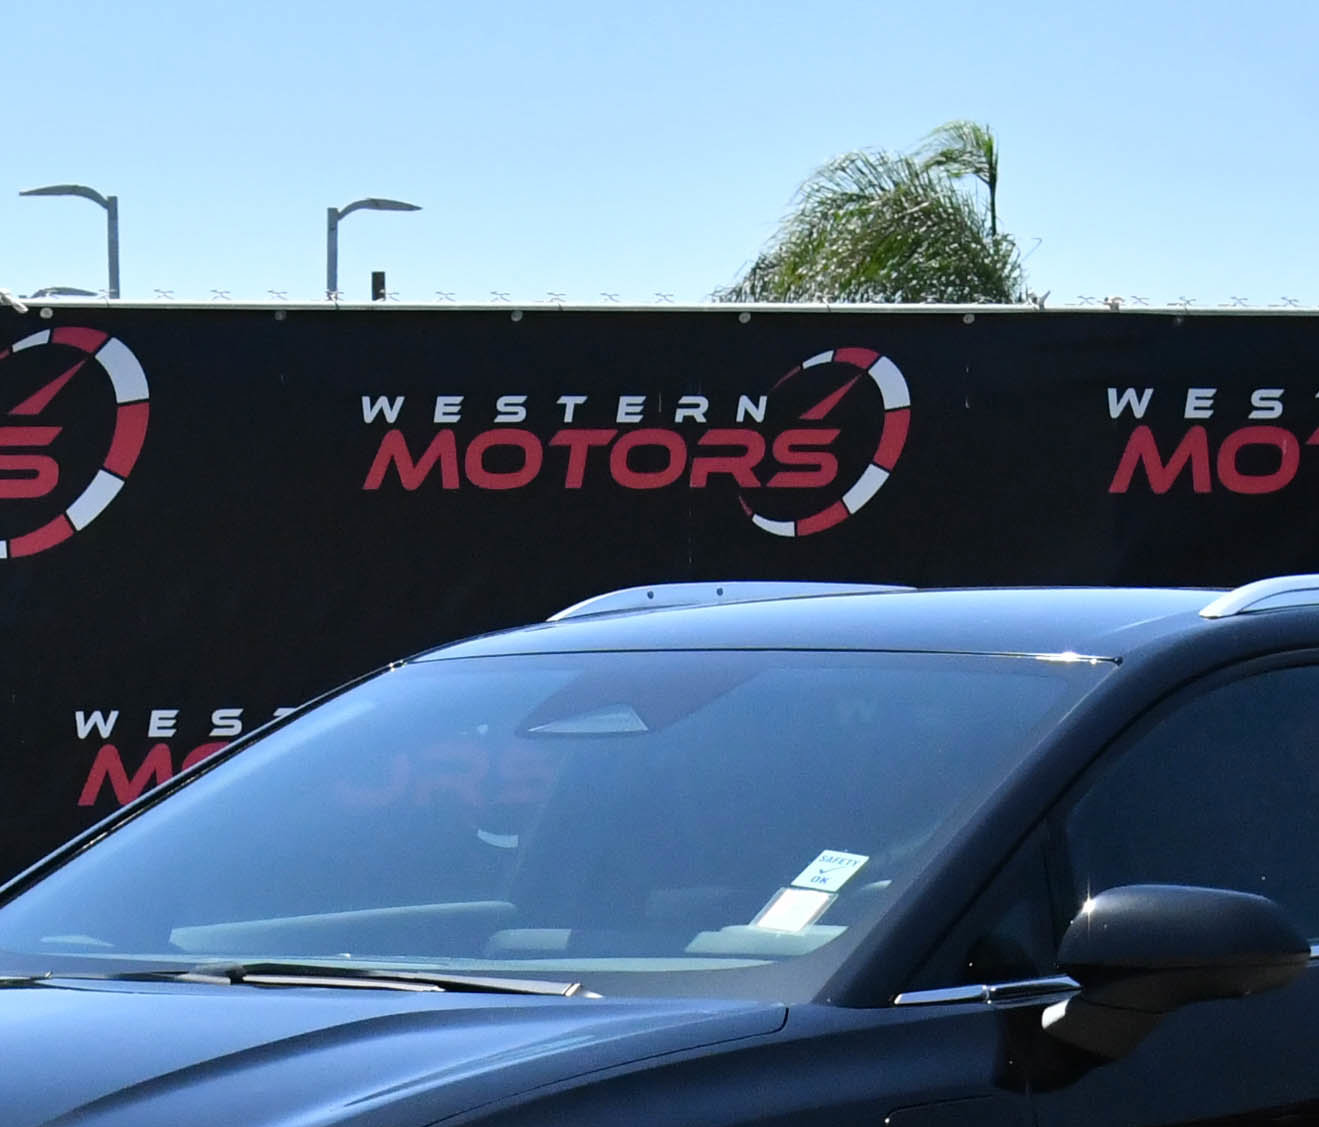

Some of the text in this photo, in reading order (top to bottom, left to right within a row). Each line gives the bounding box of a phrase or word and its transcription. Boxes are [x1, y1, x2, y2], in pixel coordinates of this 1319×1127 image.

[361, 394, 768, 424] WESTERN
[362, 428, 841, 491] MOTORS
[819, 855, 860, 867] SAFETY
[810, 875, 829, 885] OK
